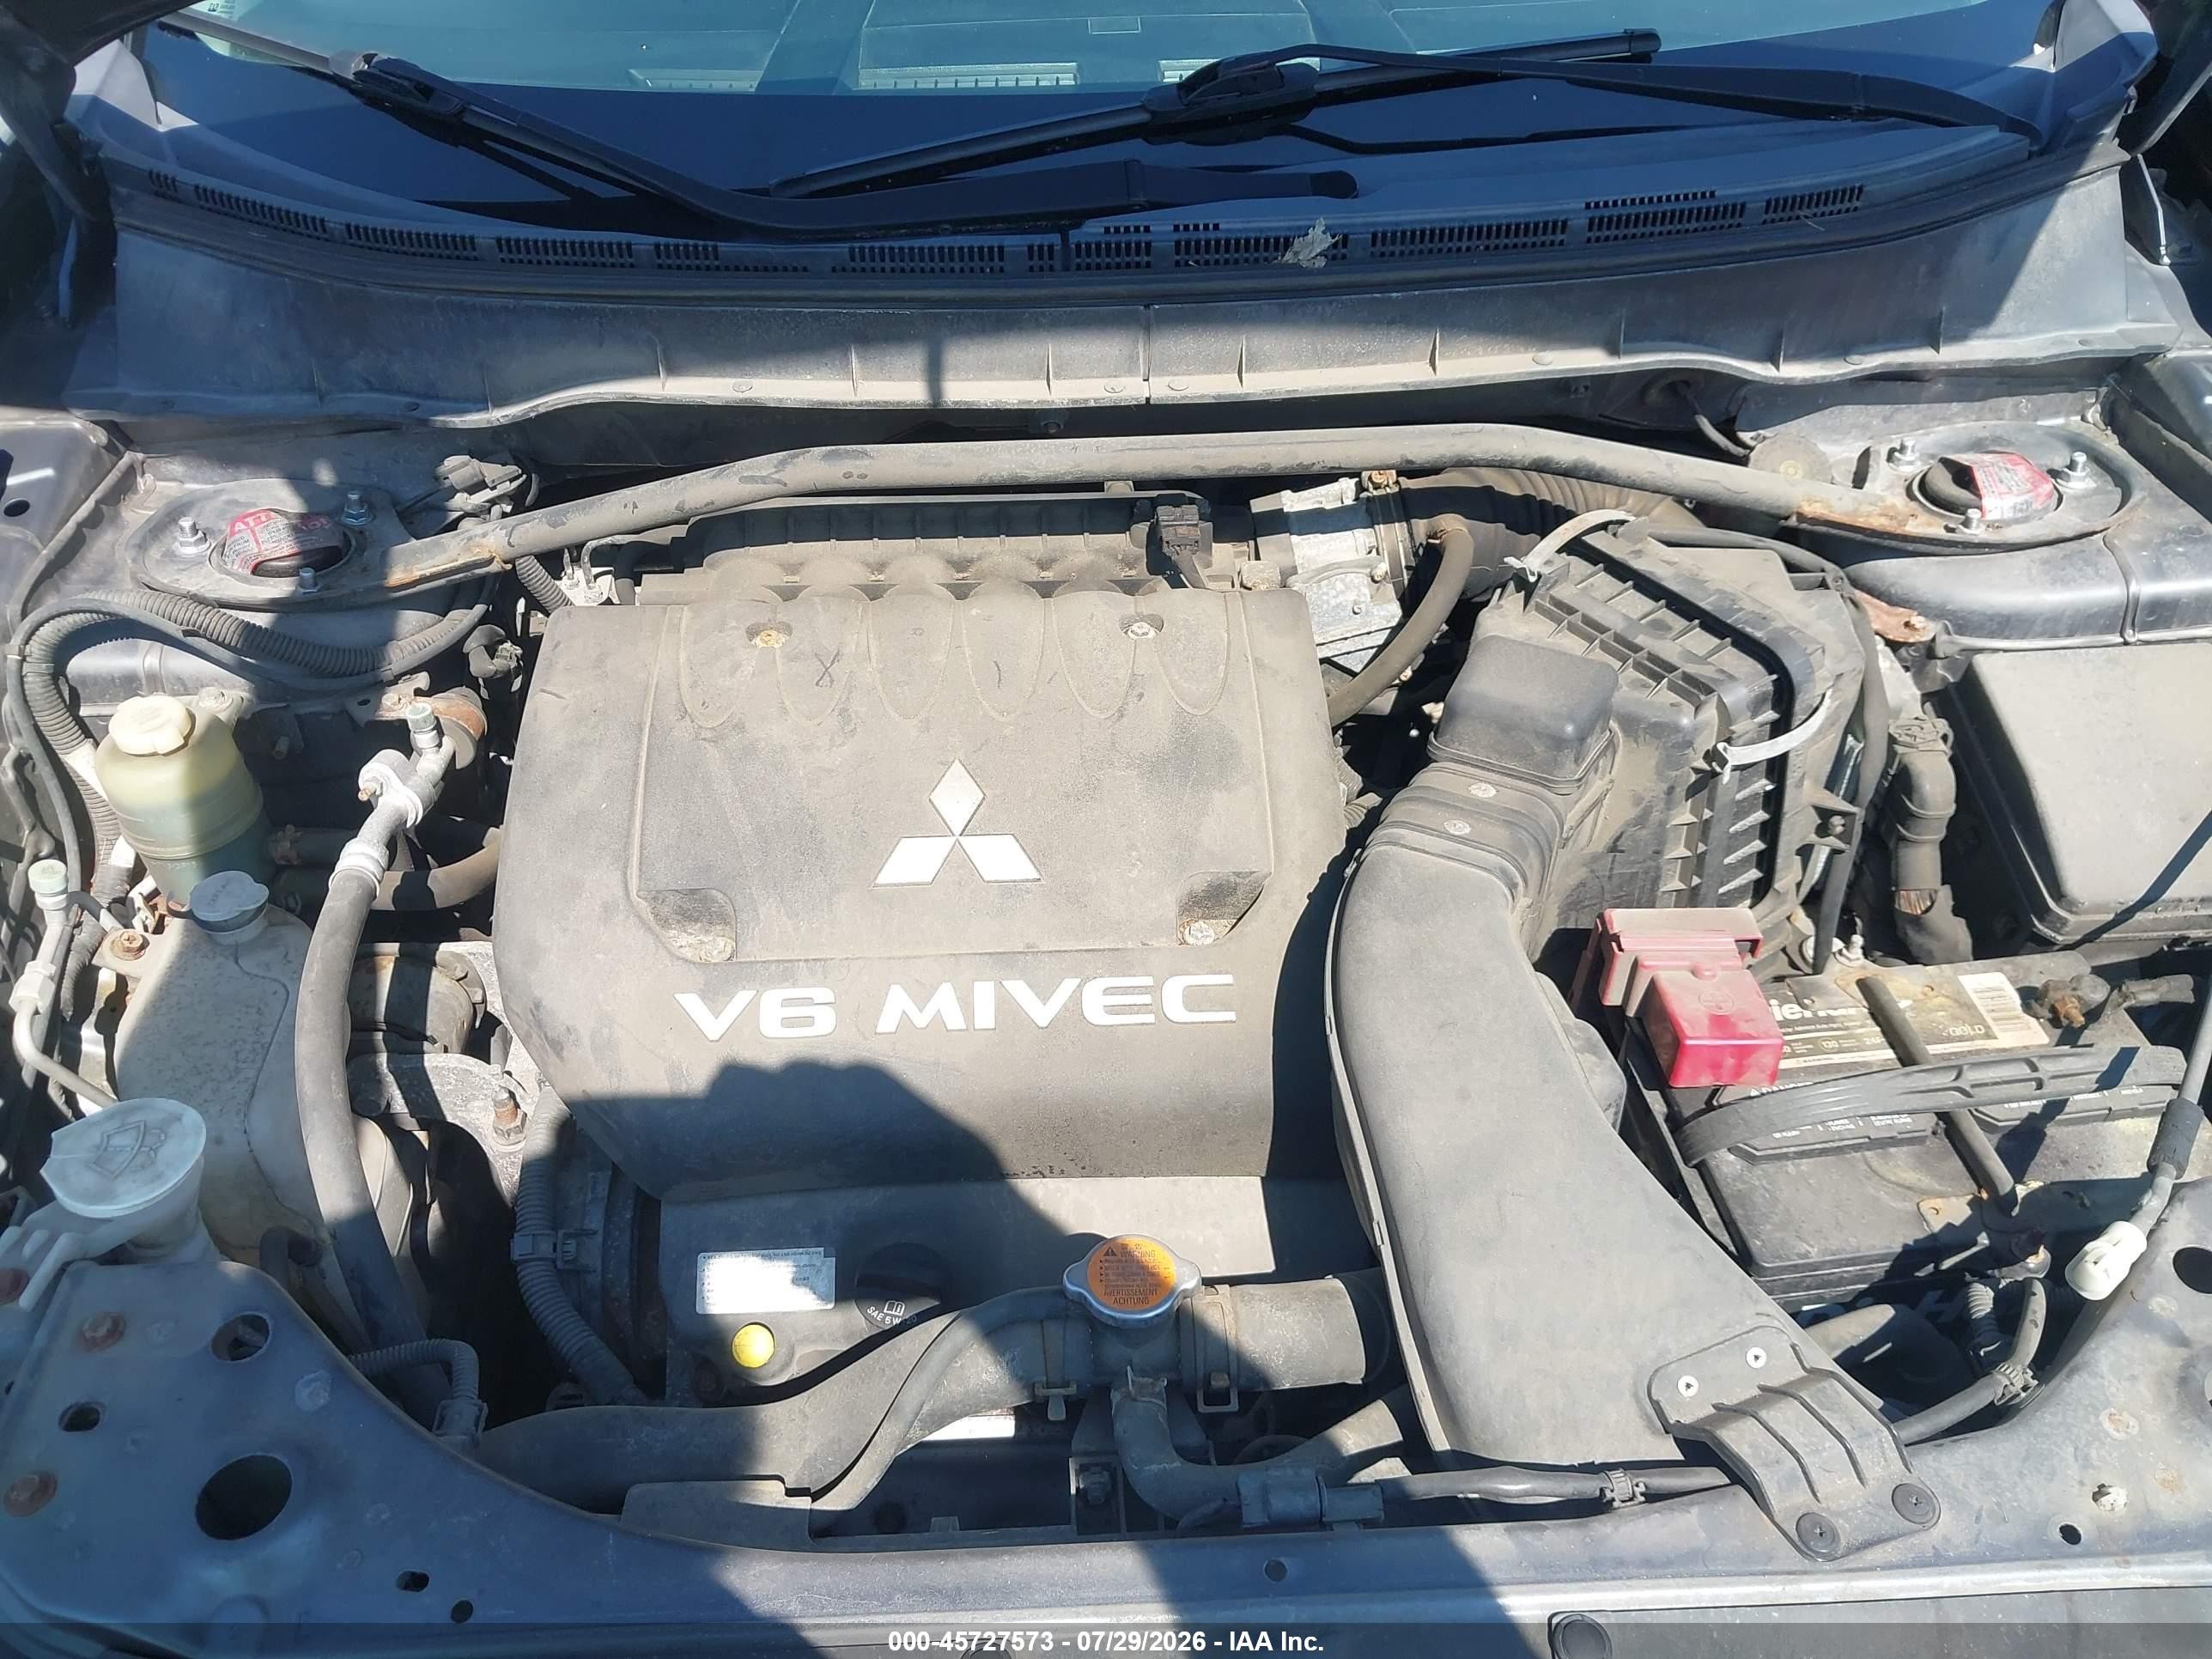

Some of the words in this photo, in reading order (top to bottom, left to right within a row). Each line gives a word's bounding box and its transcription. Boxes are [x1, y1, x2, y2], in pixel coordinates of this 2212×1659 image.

[673, 987, 837, 1042] V6
[875, 974, 1237, 1034] MIVEC
[1120, 1249, 1156, 1258] WARNING
[1104, 1288, 1158, 1297] AVERTISSEMENT
[1113, 1297, 1150, 1305] ACHTUNG
[866, 1306, 885, 1322] SAE
